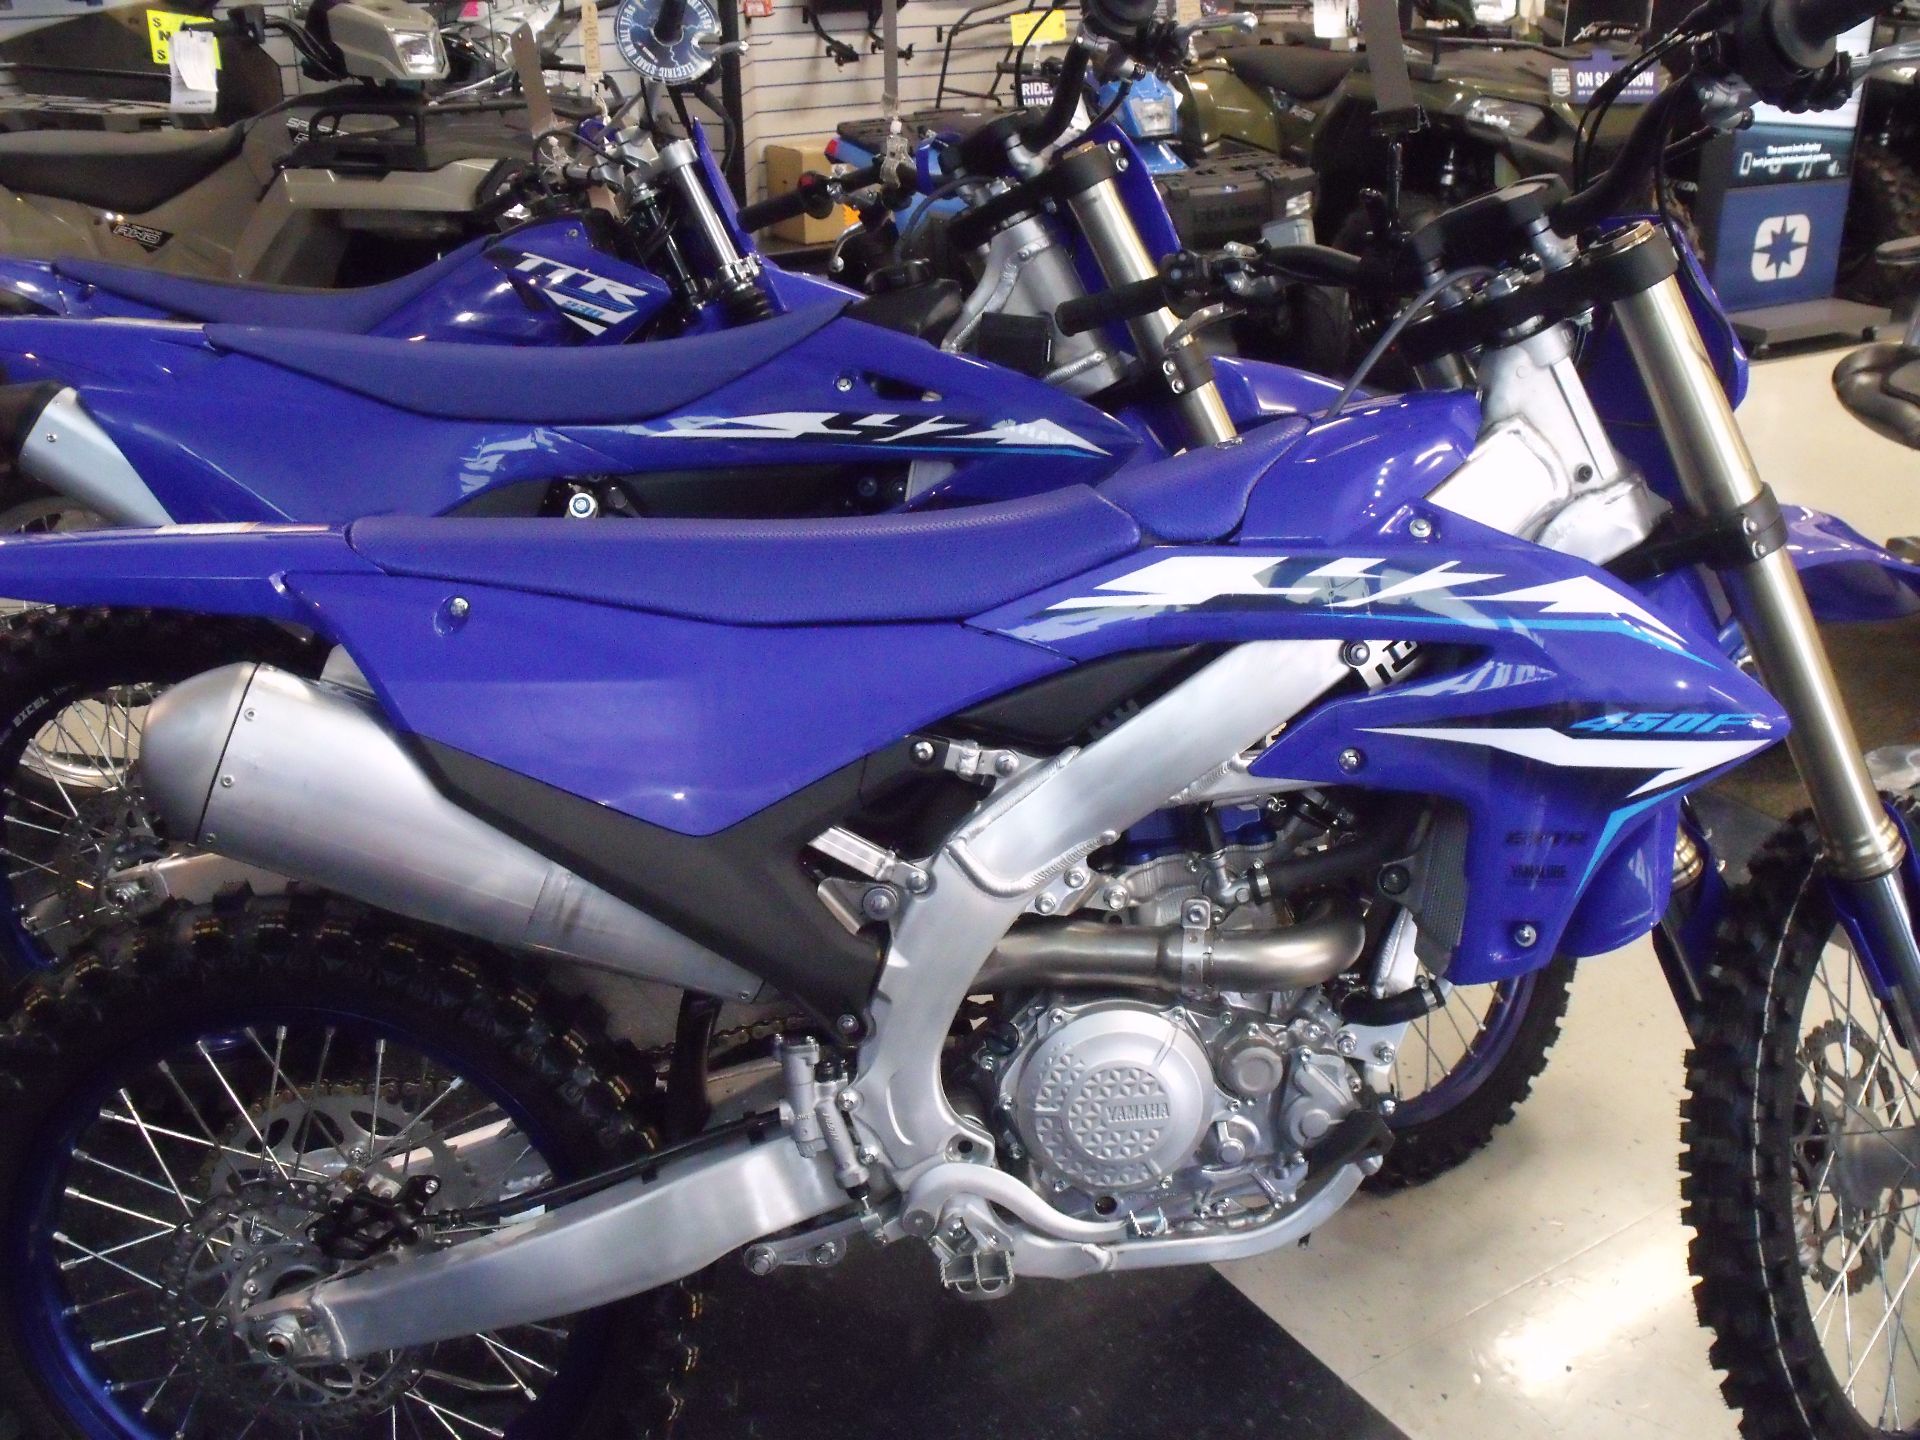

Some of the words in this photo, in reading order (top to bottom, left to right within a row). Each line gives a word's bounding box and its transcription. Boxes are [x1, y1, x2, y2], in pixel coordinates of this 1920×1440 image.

[633, 55, 657, 75] START
[659, 61, 696, 78] ELECTRIC
[1021, 81, 1053, 96] RIDE.
[1576, 71, 1593, 87] ON
[13, 696, 49, 728] EXCEL
[1568, 711, 1766, 734] 450F
[1105, 1102, 1170, 1123] YAMAHA
